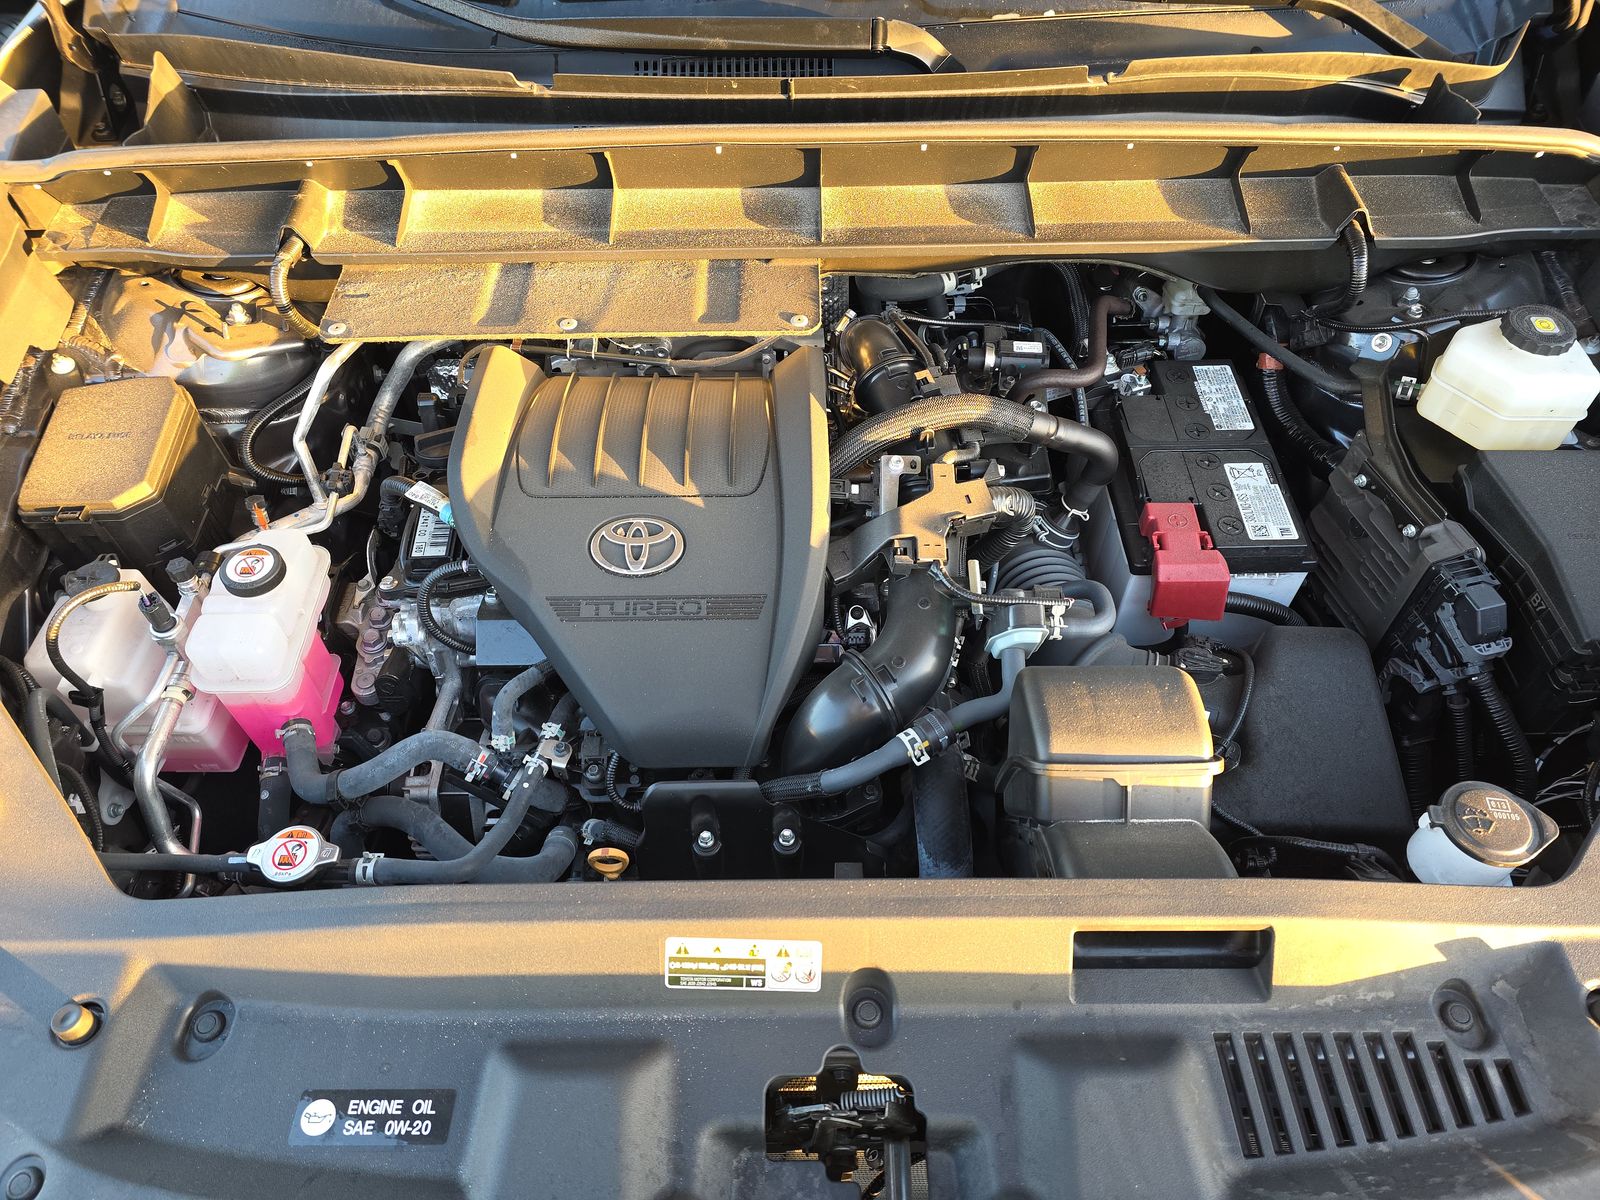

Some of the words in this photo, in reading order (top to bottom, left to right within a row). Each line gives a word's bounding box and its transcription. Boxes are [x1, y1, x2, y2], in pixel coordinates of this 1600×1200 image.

[1279, 527, 1293, 537] TM
[584, 600, 702, 617] TURBO
[1530, 592, 1547, 612] B7
[750, 978, 763, 987] WS
[347, 1099, 404, 1115] ENGINE
[412, 1099, 436, 1115] OIL
[342, 1120, 375, 1136] SAE
[384, 1120, 432, 1136] 0W-20
